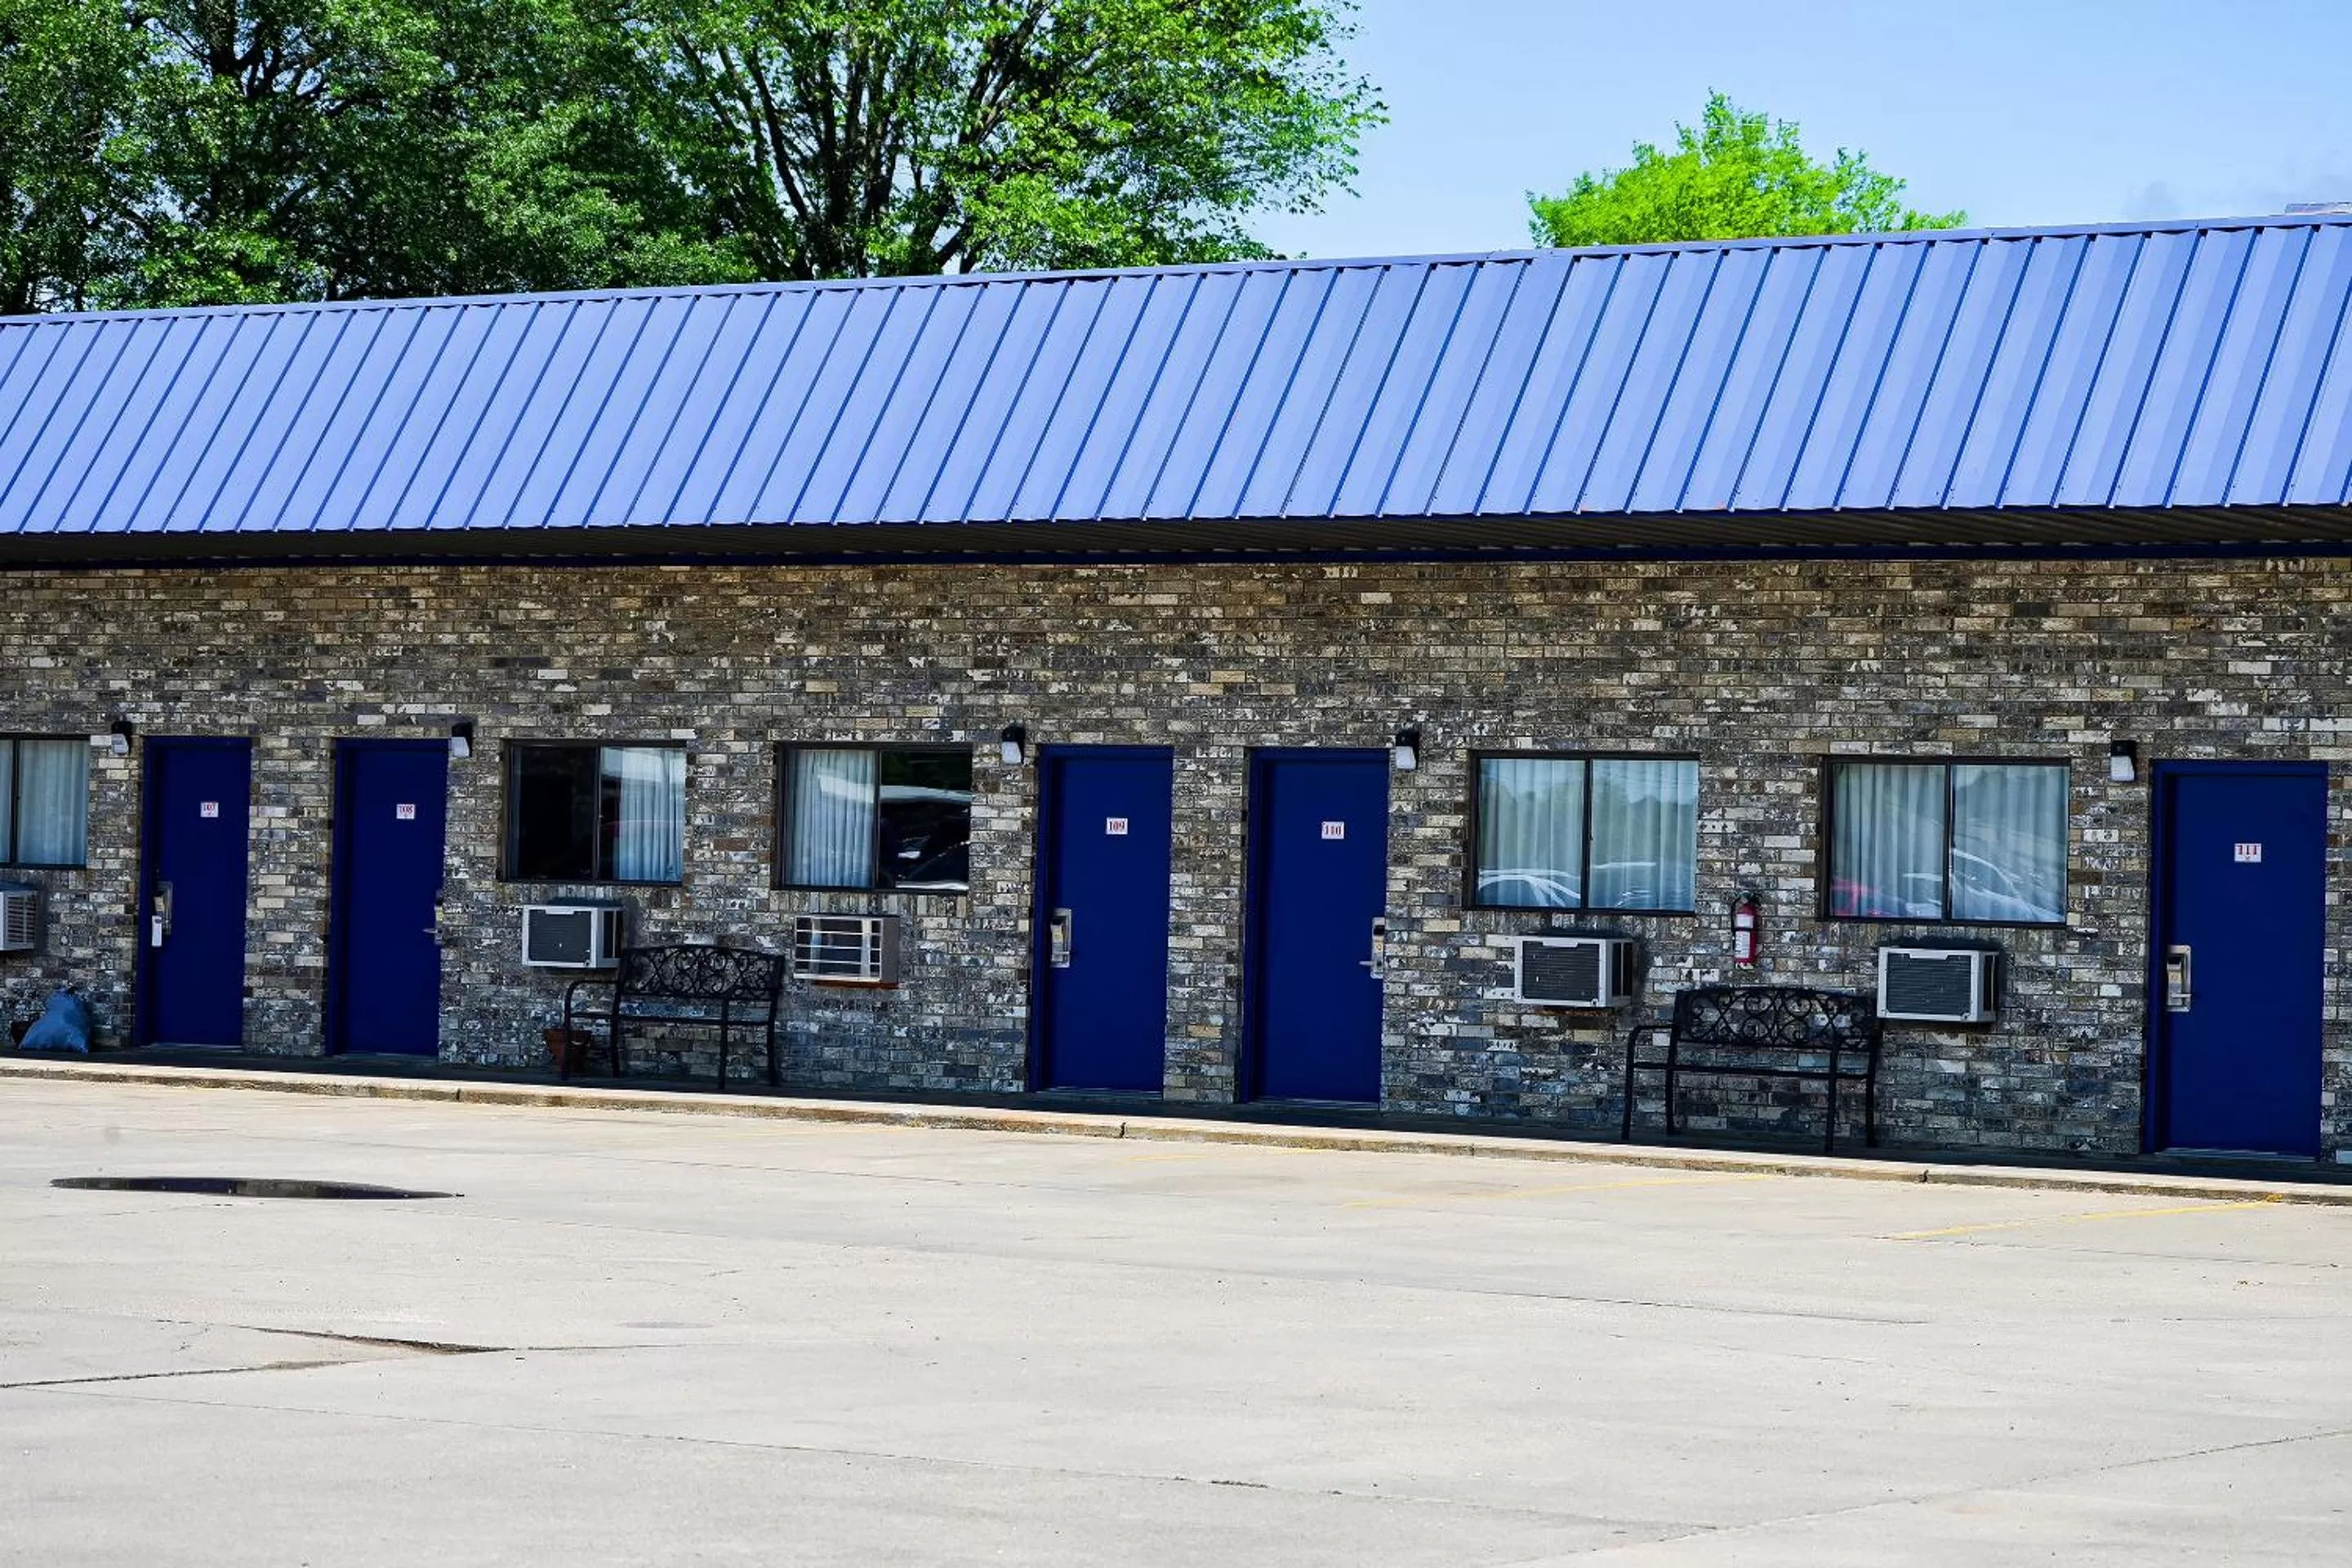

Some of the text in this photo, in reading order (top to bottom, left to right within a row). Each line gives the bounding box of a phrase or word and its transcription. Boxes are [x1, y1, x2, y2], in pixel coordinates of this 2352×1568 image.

[1109, 820, 1125, 831] 109
[1325, 826, 1342, 835] 110
[2238, 844, 2258, 855] 111
